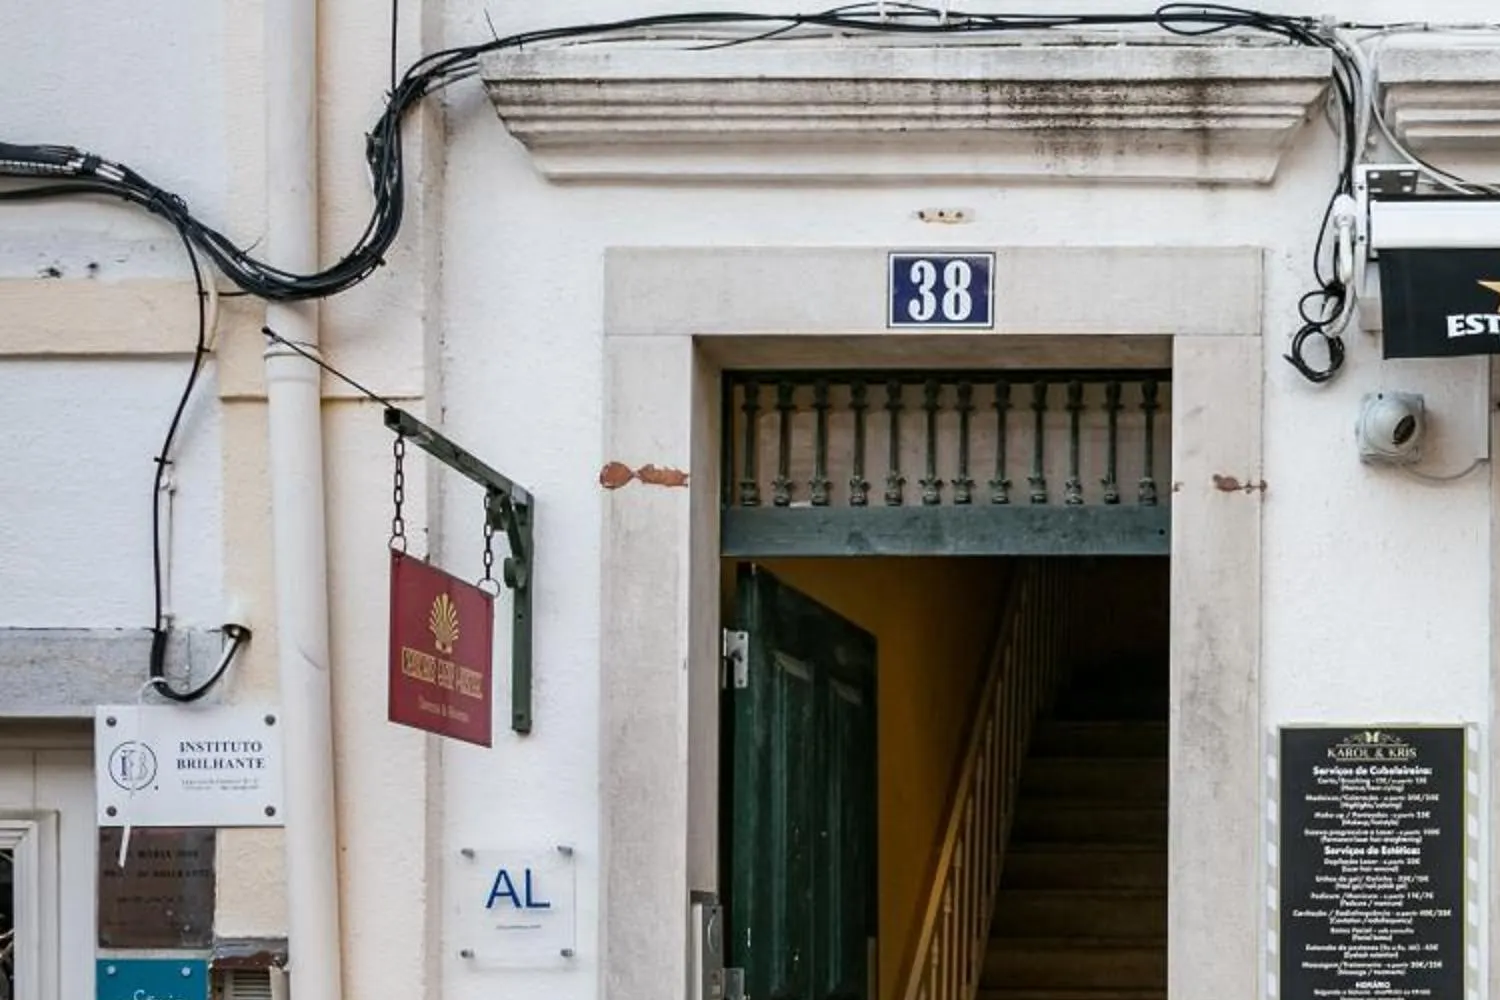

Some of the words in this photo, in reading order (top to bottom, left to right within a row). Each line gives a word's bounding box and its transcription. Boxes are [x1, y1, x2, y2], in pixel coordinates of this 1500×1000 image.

[908, 260, 972, 321] 38
[179, 741, 263, 753] INSTITUTO
[1389, 748, 1417, 757] KRIS
[176, 758, 265, 769] BRILHANTE
[1355, 766, 1367, 775] de
[1366, 846, 1379, 855] de
[486, 868, 551, 908] AL
